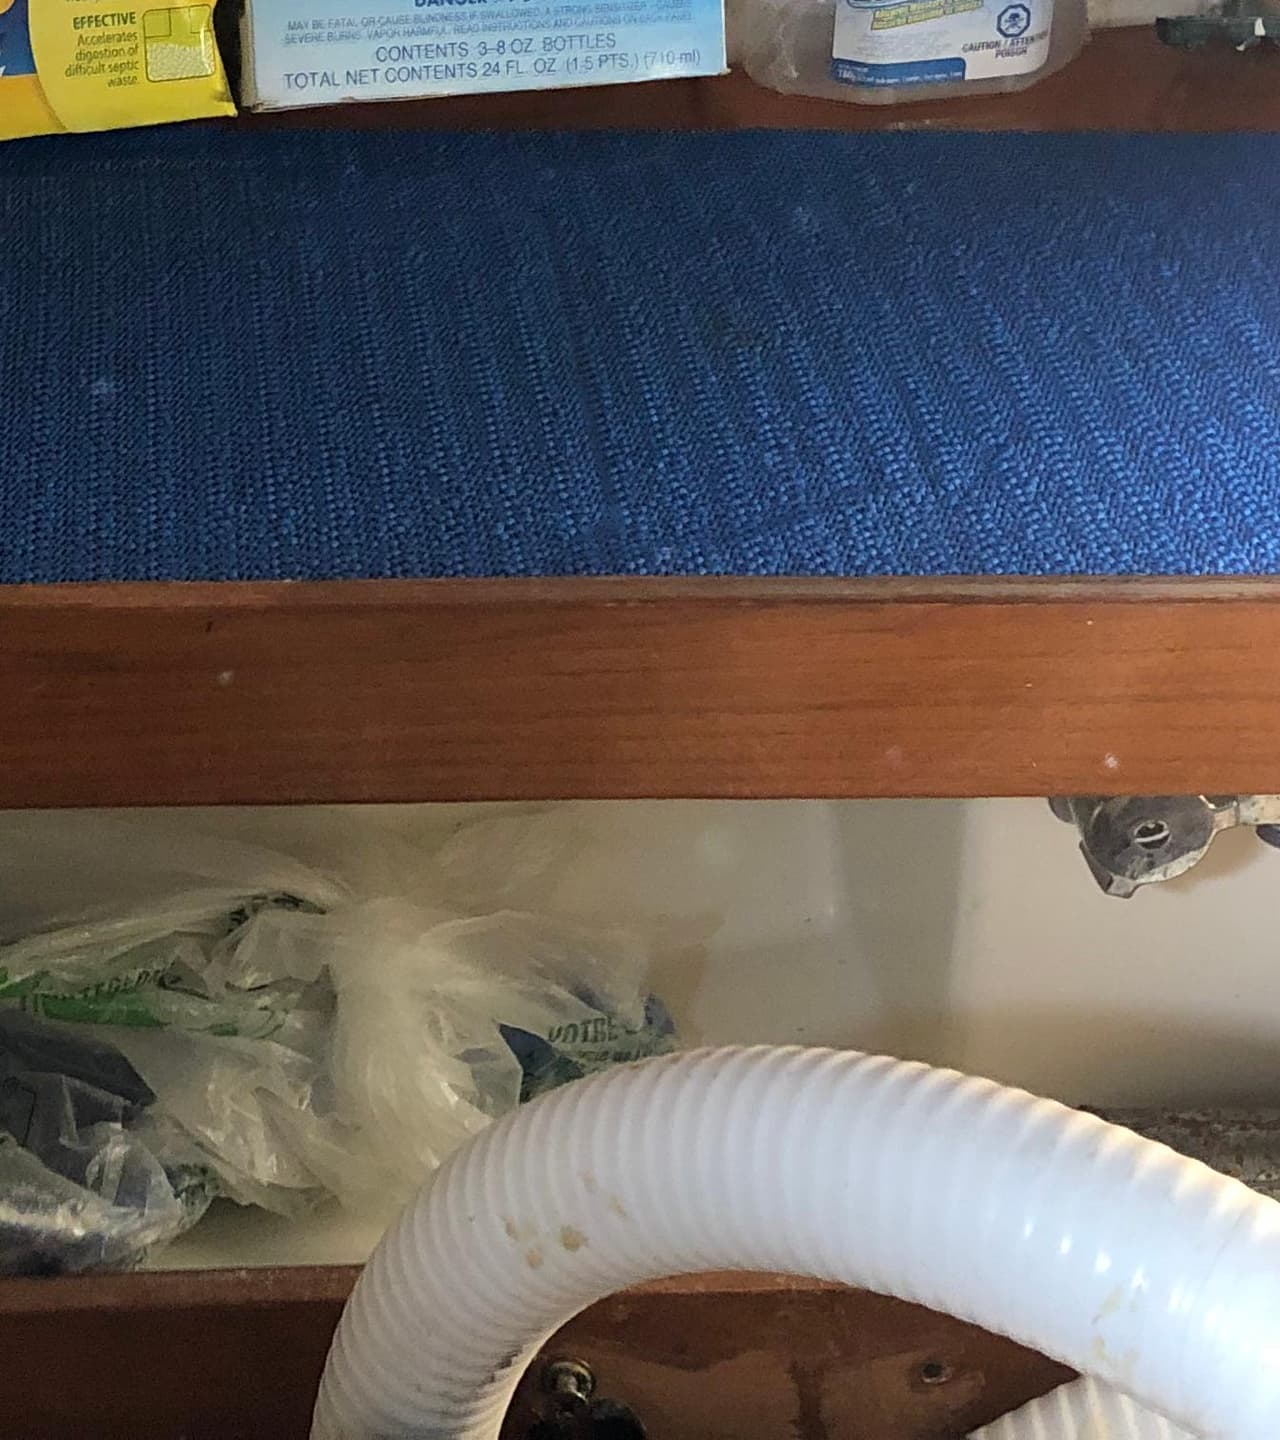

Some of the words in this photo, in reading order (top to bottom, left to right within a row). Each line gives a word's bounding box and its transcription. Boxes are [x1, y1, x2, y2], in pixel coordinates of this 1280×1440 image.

[72, 11, 137, 30] EFFECTIVE
[288, 21, 309, 31] MAY
[312, 20, 324, 30] BE
[328, 18, 358, 29] FATAL
[361, 16, 376, 26] OR
[414, 12, 468, 25] BLINDNESS
[77, 31, 138, 47] Accelerates
[285, 32, 326, 44] SEVERE
[368, 28, 400, 41] VAPOR
[75, 46, 125, 62] digestion
[128, 45, 139, 57] of
[376, 42, 469, 62] CONTENTS
[542, 33, 617, 53] BOTTLES
[962, 40, 1000, 53] CAUTION
[65, 61, 106, 78] difficult
[108, 59, 140, 74] septic
[284, 68, 342, 89] TOTAL
[346, 67, 379, 86] NET
[381, 62, 478, 84] CONTENTS
[482, 61, 500, 77] 24
[679, 48, 701, 66] ml)
